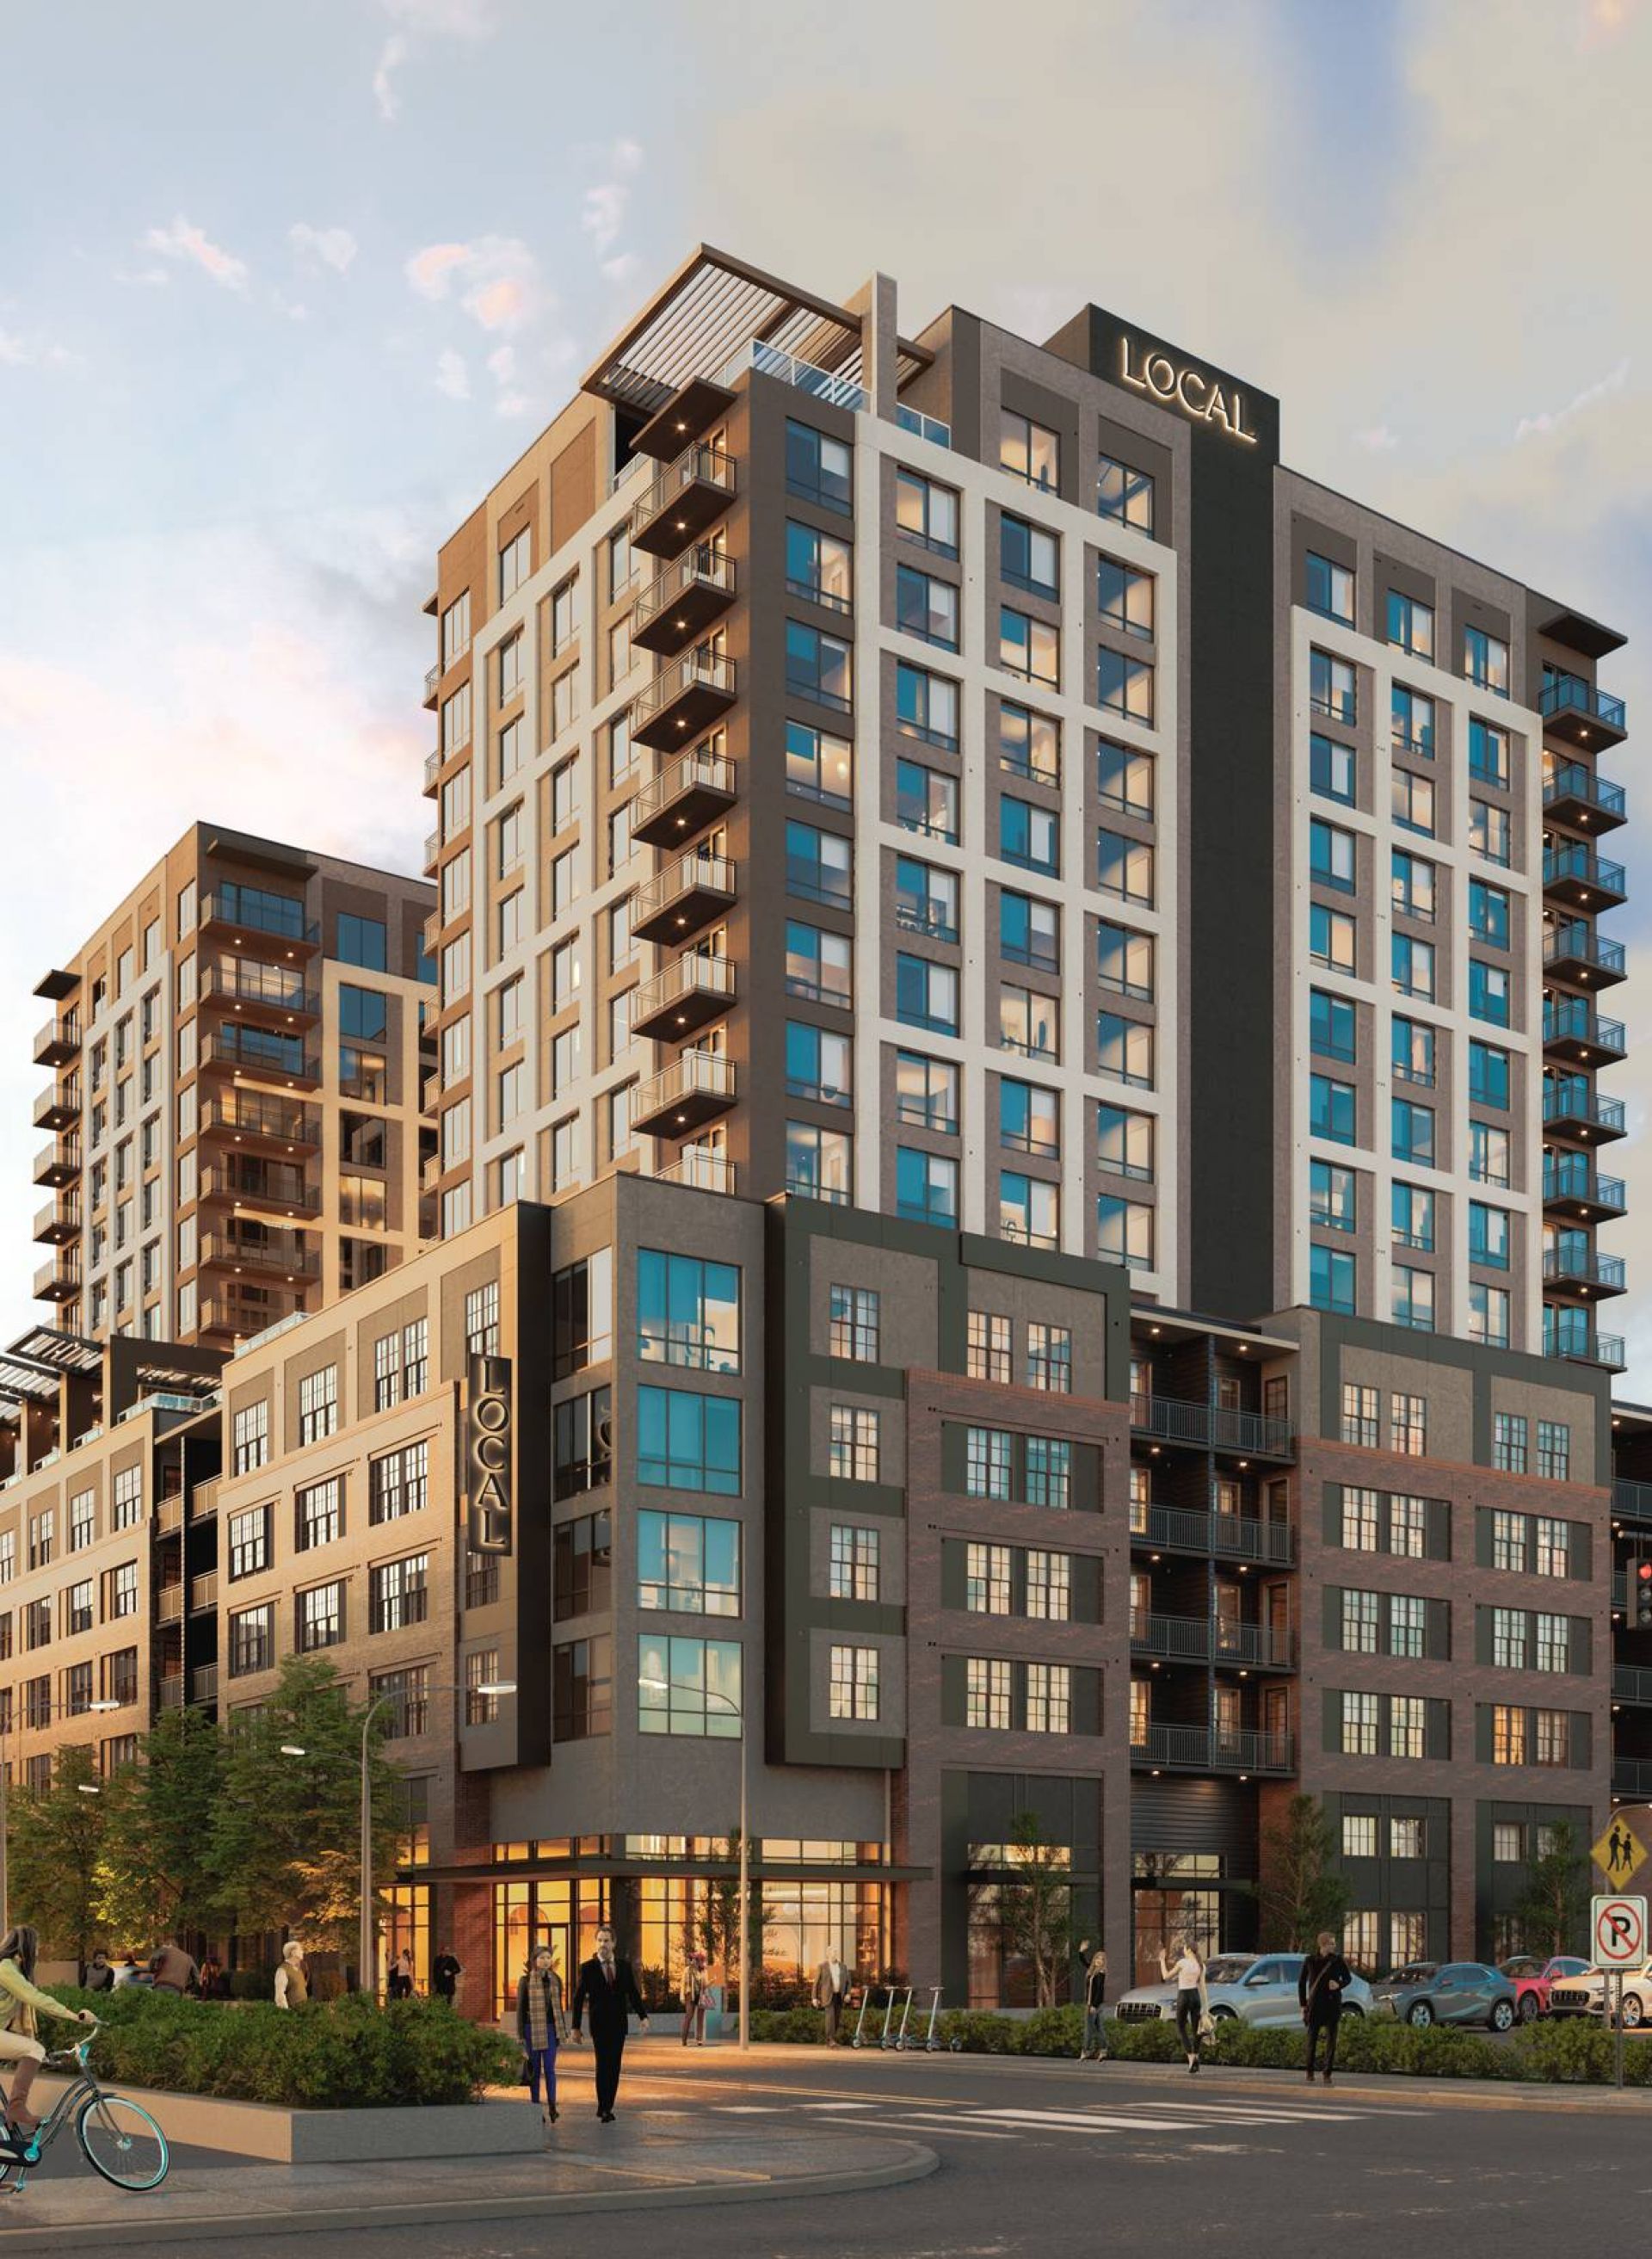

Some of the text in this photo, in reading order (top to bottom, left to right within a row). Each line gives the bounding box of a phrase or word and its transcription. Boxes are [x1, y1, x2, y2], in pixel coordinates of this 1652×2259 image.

[1121, 336, 1257, 442] LOCAL
[476, 1359, 509, 1545] LOCAL
[1612, 1916, 1630, 1947] P
